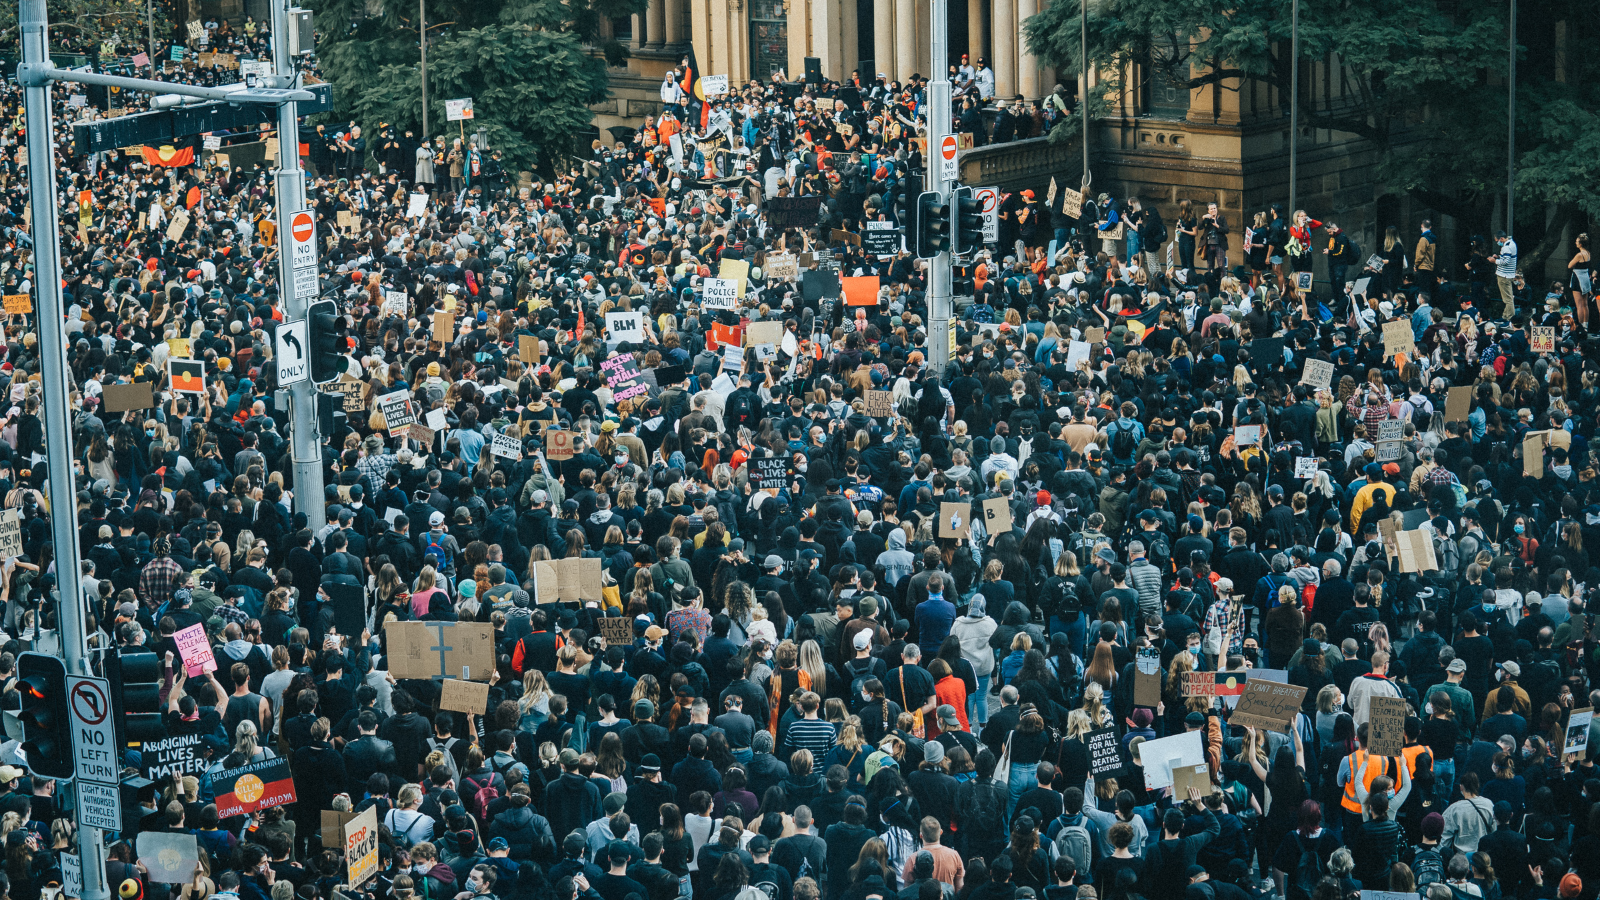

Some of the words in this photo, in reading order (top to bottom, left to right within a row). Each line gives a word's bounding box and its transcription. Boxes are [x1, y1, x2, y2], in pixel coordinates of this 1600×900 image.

[958, 135, 972, 148] LM
[942, 170, 957, 178] ENTRY
[1098, 229, 1122, 238] RACISM
[298, 245, 310, 254] NO
[294, 255, 315, 266] ENTRY
[708, 288, 736, 296] POLICE
[703, 297, 735, 306] BRUTALITY
[613, 319, 636, 332] BLM
[1532, 327, 1553, 336] BLACK
[1393, 345, 1407, 353] BLM
[600, 353, 635, 372] RACISM
[280, 364, 305, 379] ONLY
[612, 364, 626, 376] IS
[607, 368, 641, 388] SMALL
[323, 383, 347, 393] ACCEPT
[351, 382, 363, 392] MY
[613, 382, 647, 403] ENERGY
[343, 391, 361, 399] TANCE
[869, 391, 890, 401] BLAK
[385, 402, 406, 414] BLACK
[868, 401, 892, 410] LIVES
[387, 411, 405, 421] LIVES
[865, 408, 892, 418] MATTER
[388, 416, 414, 428] MATTER
[494, 434, 520, 445] PROTECT
[494, 440, 520, 451] SACRED
[757, 459, 786, 469] BLACK
[764, 468, 787, 478] LIVES
[759, 478, 788, 488] MATTER
[986, 508, 996, 519] B
[0, 521, 19, 534] GINAL
[12, 533, 21, 544] IN
[599, 619, 631, 630] BLACK
[176, 627, 202, 642] WHITE
[601, 629, 629, 638] LIVES
[178, 634, 207, 651] SILENCE
[184, 650, 214, 667] DEATH
[1181, 673, 1190, 684] NO
[1189, 672, 1215, 684] JUSTICE
[1181, 684, 1190, 695] NO
[1190, 684, 1215, 695] PEACE
[1241, 692, 1256, 711] 8
[1268, 696, 1285, 715] 46
[1378, 698, 1406, 708] CANNOT
[1371, 707, 1391, 716] TEACH
[1371, 717, 1403, 727] CHILDREN
[81, 728, 105, 746] NO
[1089, 731, 1115, 743] JUSTICE
[1390, 732, 1400, 740] THE
[1088, 741, 1104, 752] FOR
[1104, 738, 1118, 748] ALL
[81, 748, 109, 761] LEFT
[158, 747, 194, 763] LIVES
[1092, 746, 1117, 758] BLACK
[1091, 754, 1120, 768] DEATHS
[1098, 761, 1123, 773] CUSTODY
[81, 763, 113, 778] TURN
[148, 758, 205, 780] MATTER
[238, 775, 254, 785] STOP
[81, 785, 100, 795] LIGHT
[100, 788, 115, 798] RAIL
[234, 782, 264, 796] KILLING
[83, 795, 115, 808] AUTHORISED
[243, 792, 256, 803] US
[85, 805, 115, 817] VEHICLES
[218, 805, 244, 819] GUNHA
[260, 792, 293, 808] MABIDYA
[85, 815, 116, 828] EXCEPTED
[348, 826, 367, 849] STOP
[349, 837, 369, 867] BLACK
[65, 856, 80, 867] HOLD
[349, 848, 378, 881] DEATHS
[351, 880, 357, 888] IN
